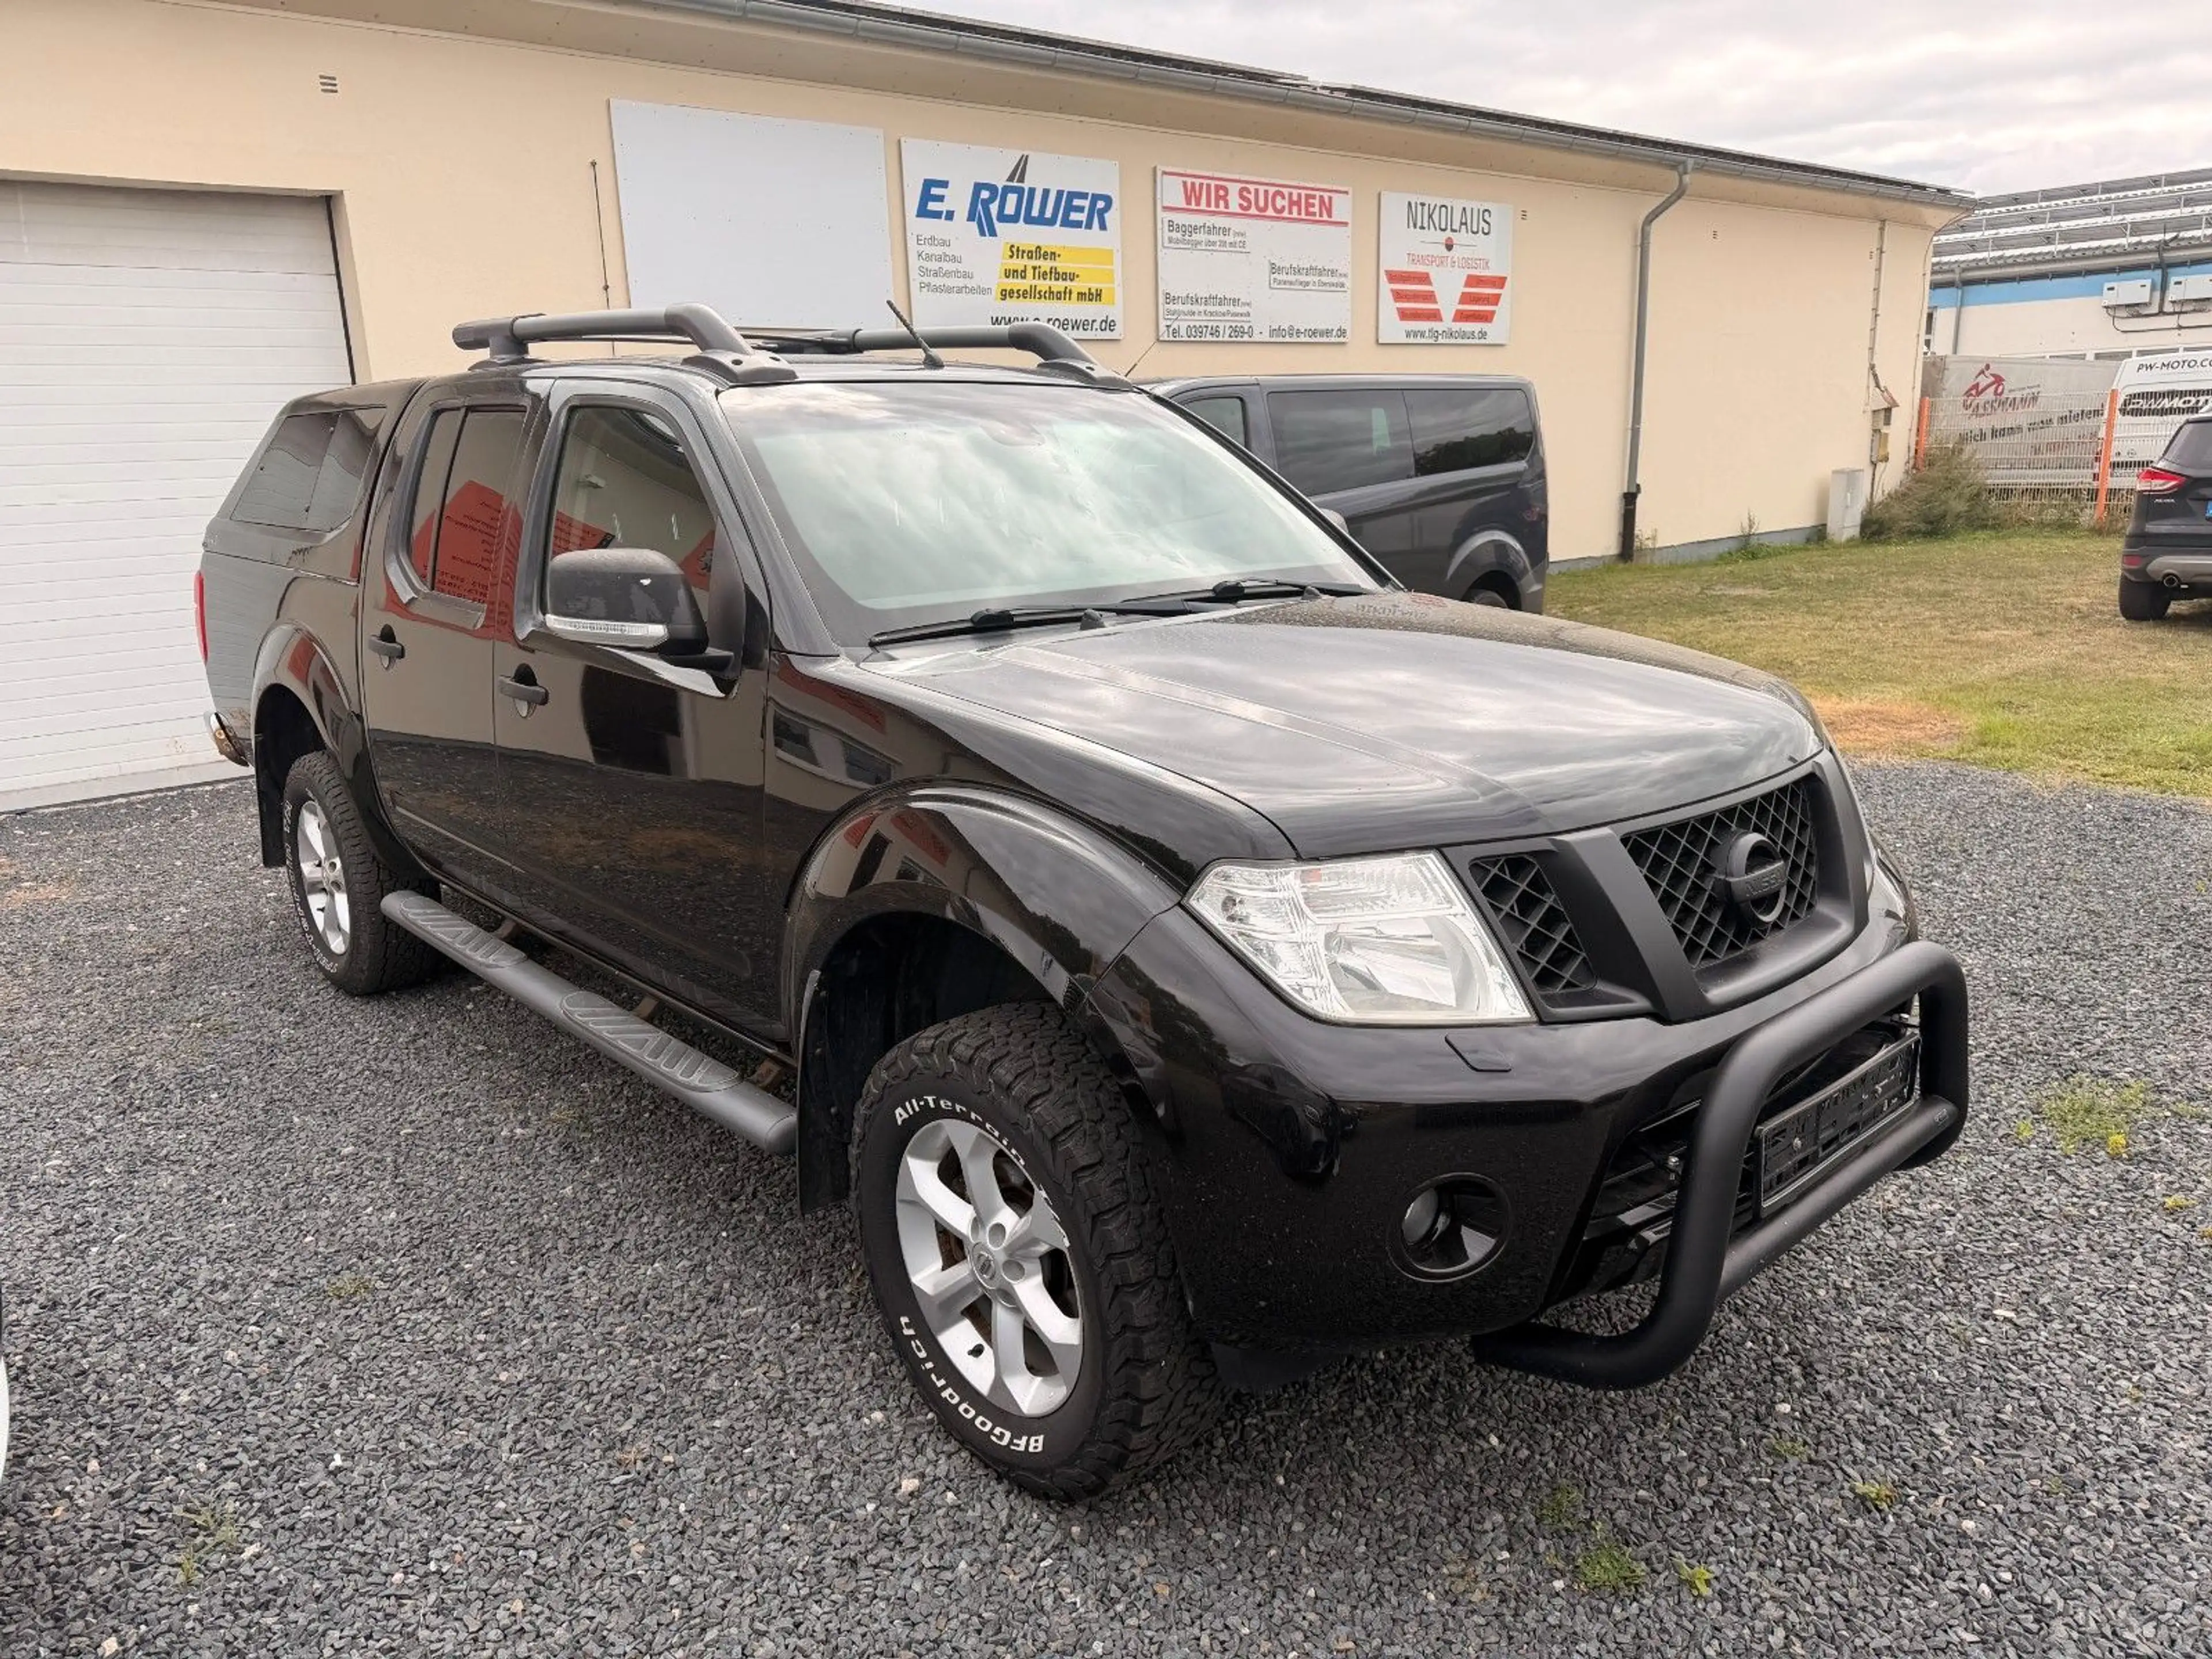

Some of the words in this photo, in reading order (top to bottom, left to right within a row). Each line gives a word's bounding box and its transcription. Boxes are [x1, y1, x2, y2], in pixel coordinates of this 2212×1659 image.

[915, 178, 955, 222] E.
[1182, 180, 1229, 210] WIR
[1238, 186, 1333, 219] SUCHEN
[1407, 200, 1491, 236] NIKOLAUS
[1168, 219, 1232, 237] Baggerfahrer
[916, 234, 950, 247] Erdbau
[917, 251, 962, 263] Kanalbau
[1008, 244, 1061, 262] Straßen-
[1406, 252, 1449, 267] TRANSPORT
[1457, 256, 1490, 270] LOGISTIK
[918, 266, 974, 279] Straßenbau
[1004, 266, 1027, 280] und
[1032, 267, 1080, 282] Tiefbau-
[1271, 263, 1338, 277] Berufskraftfahrer
[999, 286, 1073, 302] gesellschaft
[1077, 289, 1103, 302] mbH
[1165, 292, 1240, 306] Berufskraftfahrer
[1165, 325, 1183, 338] Tel.
[1186, 325, 1220, 338] 039746
[1269, 324, 1347, 339] info@e-roewer.de
[900, 1316, 1044, 1453] BFGoodrich
